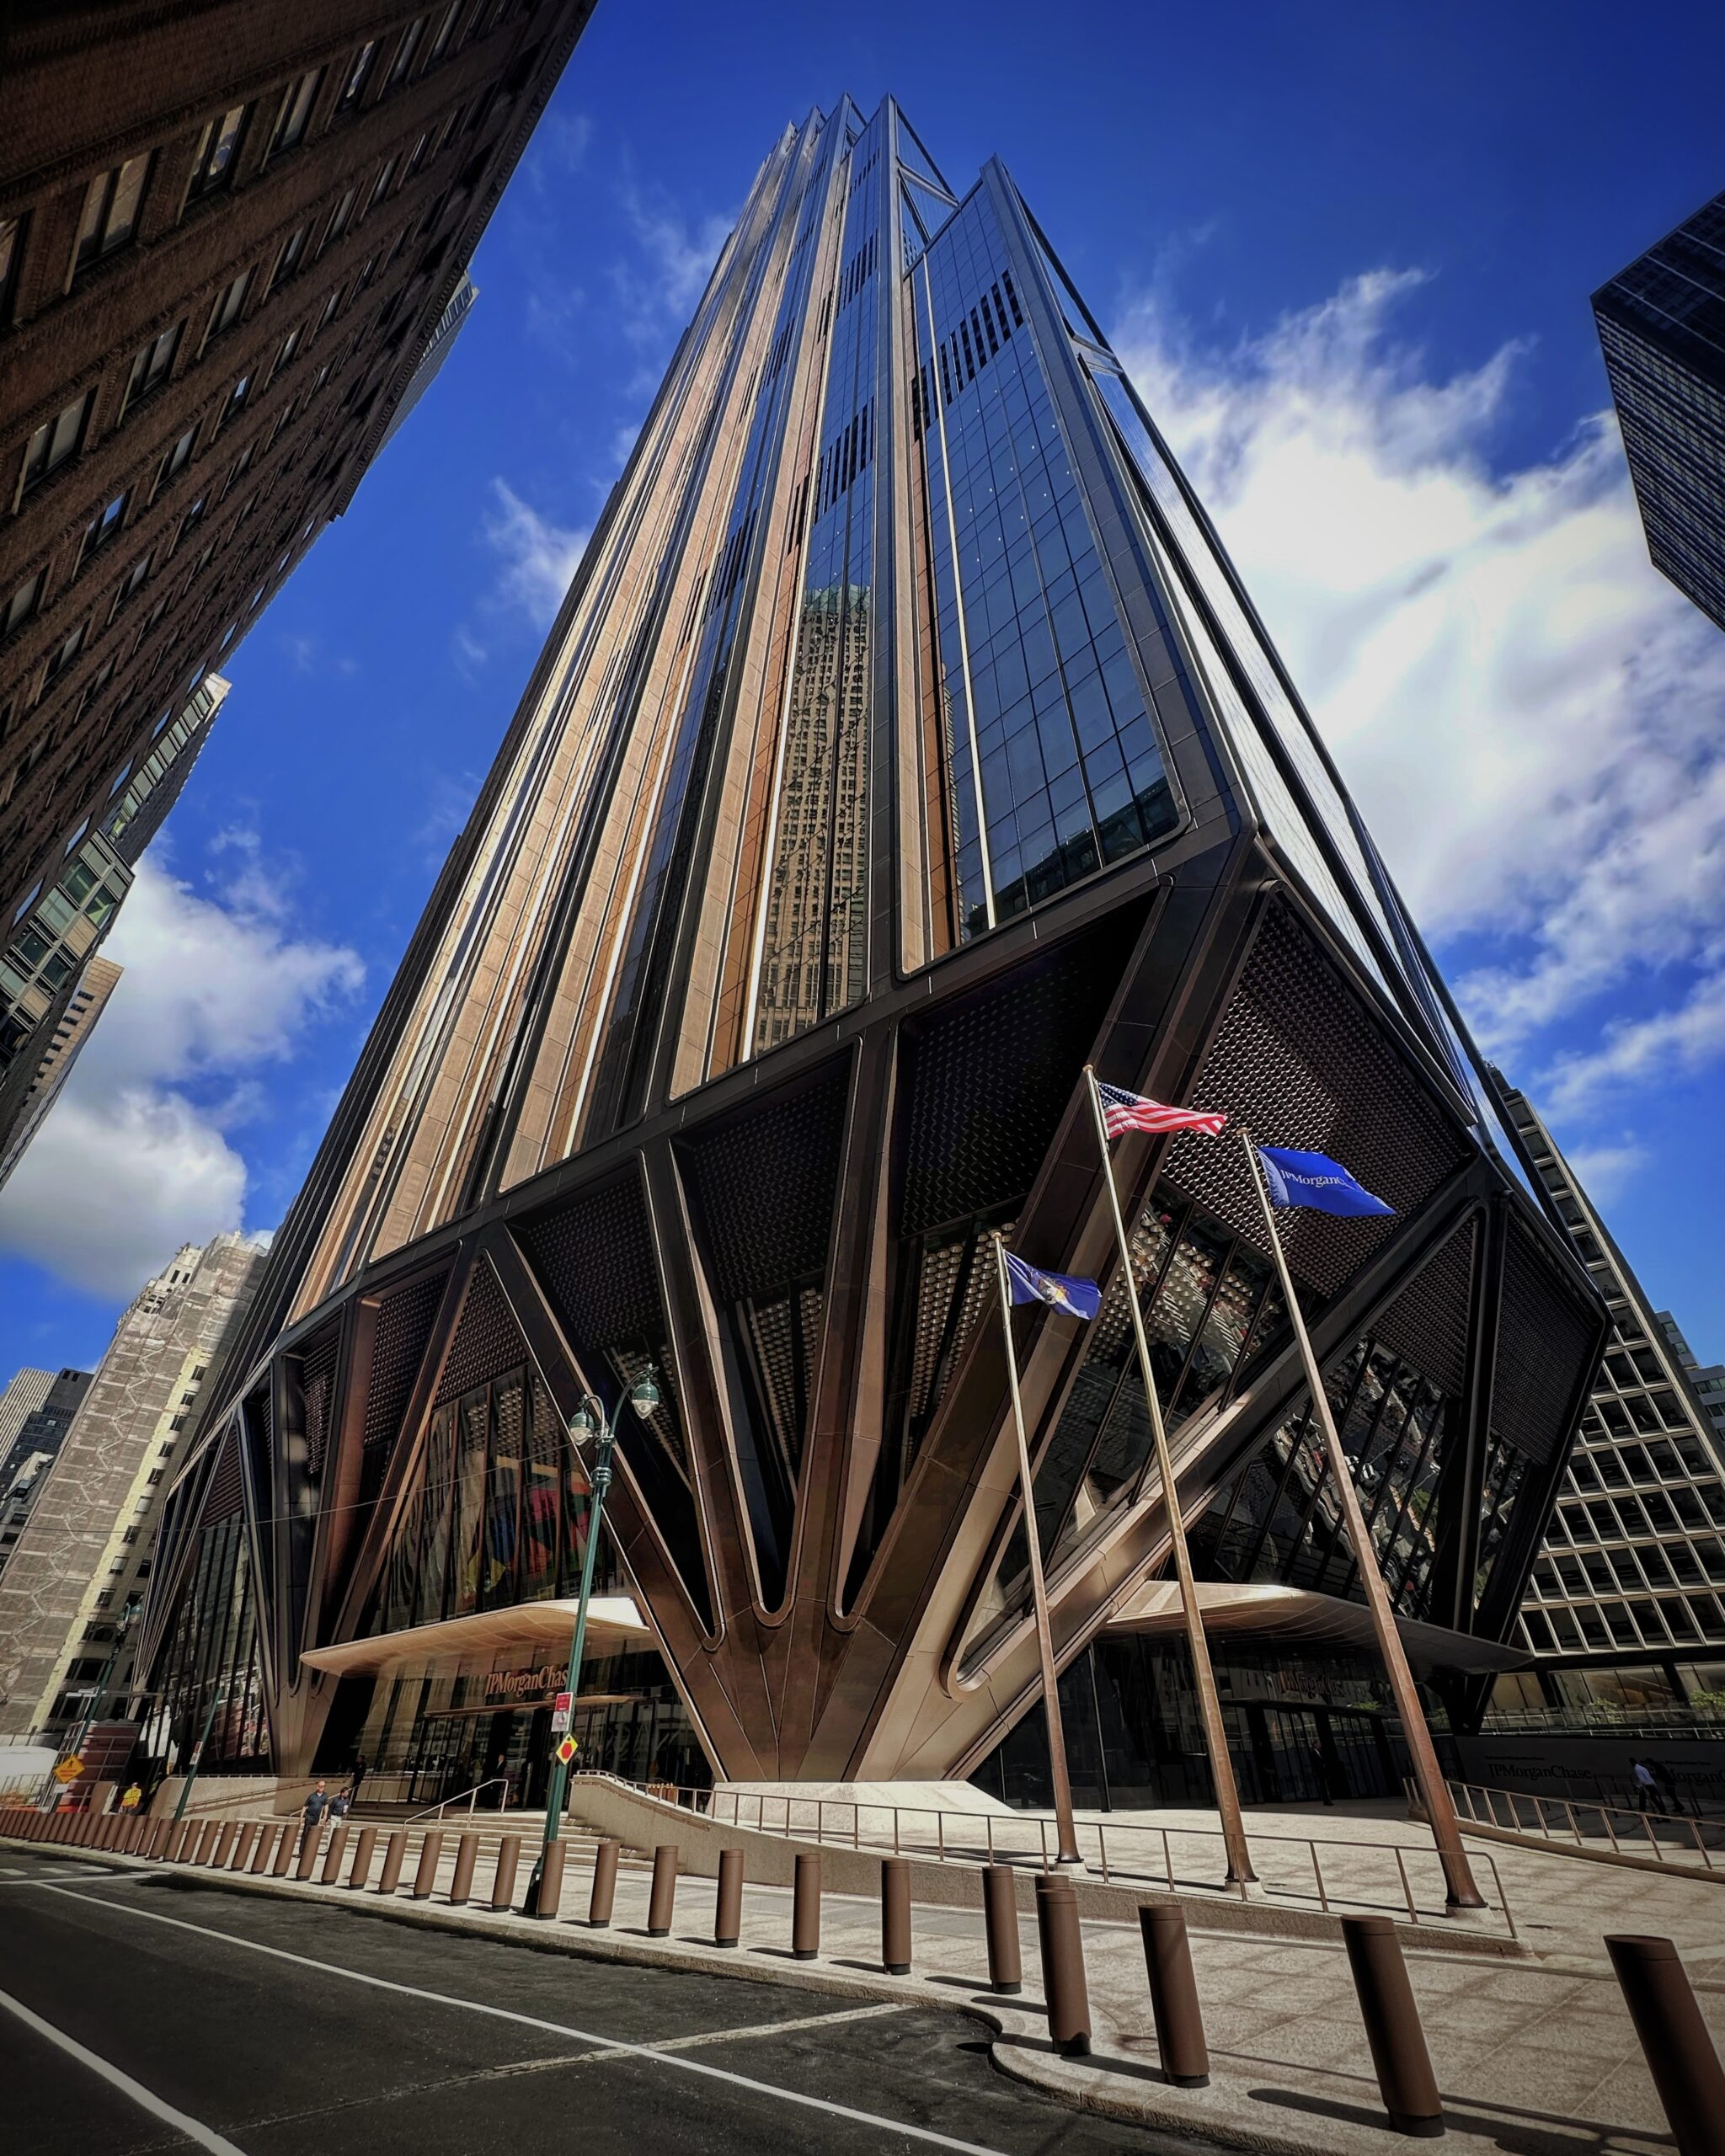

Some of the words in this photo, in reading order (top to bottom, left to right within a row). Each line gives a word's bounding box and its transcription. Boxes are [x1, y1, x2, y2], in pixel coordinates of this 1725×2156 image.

[1280, 1169, 1345, 1188] JPMorganC
[485, 1666, 569, 1697] JPMorganChas
[1487, 1764, 1592, 1780] JPMorganChase
